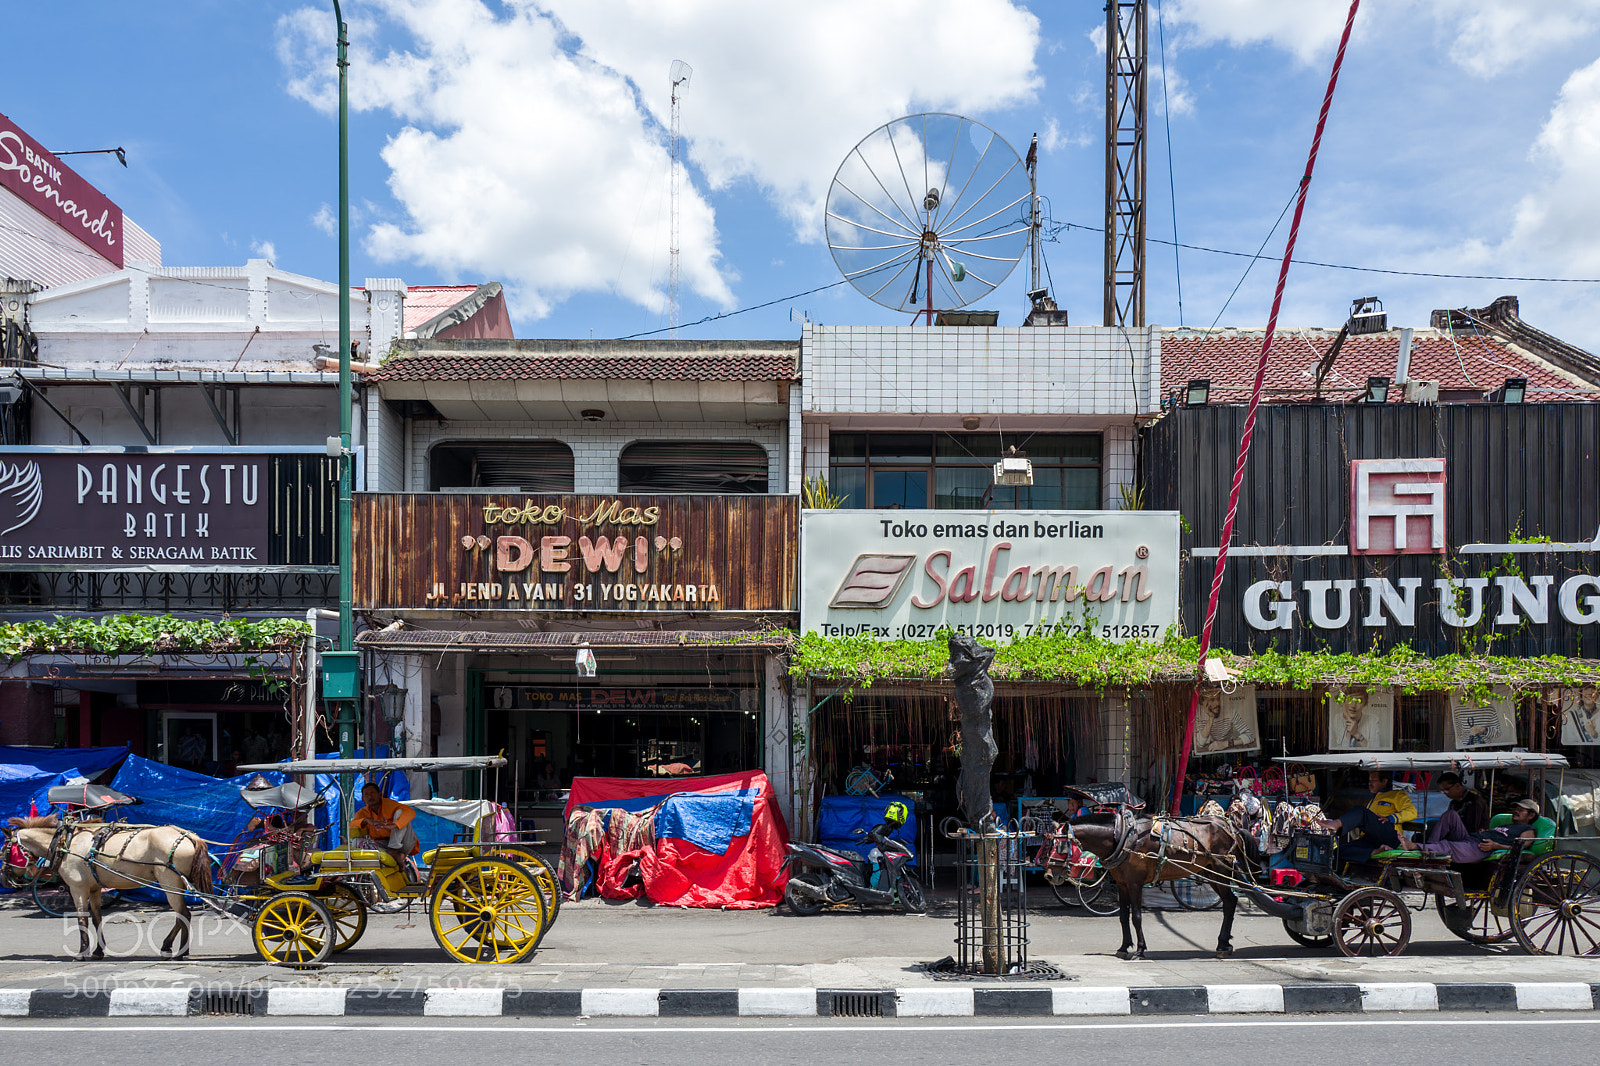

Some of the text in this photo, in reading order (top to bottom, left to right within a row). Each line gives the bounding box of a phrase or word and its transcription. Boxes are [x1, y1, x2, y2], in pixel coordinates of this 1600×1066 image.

[25, 146, 62, 186] BATIK
[0, 131, 116, 246] Soenardi
[77, 463, 258, 505] PANGESTU
[123, 512, 209, 538] BATIK
[482, 498, 662, 526] toko Mas
[880, 519, 1104, 539] Toko emas dan berlian
[0, 545, 257, 560] LIS SARIMBIT & SERAGAM BATIK
[911, 542, 1153, 610] Salaman
[453, 583, 503, 601] JEND
[523, 583, 564, 601] YANI
[573, 582, 593, 601] 31
[600, 583, 720, 602] YOGYAKARTA
[1242, 574, 1600, 631] GUNUNG
[1102, 624, 1160, 639] 512857
[524, 692, 554, 701] TOKO
[558, 692, 583, 701] MAS
[590, 689, 656, 704] DEWI
